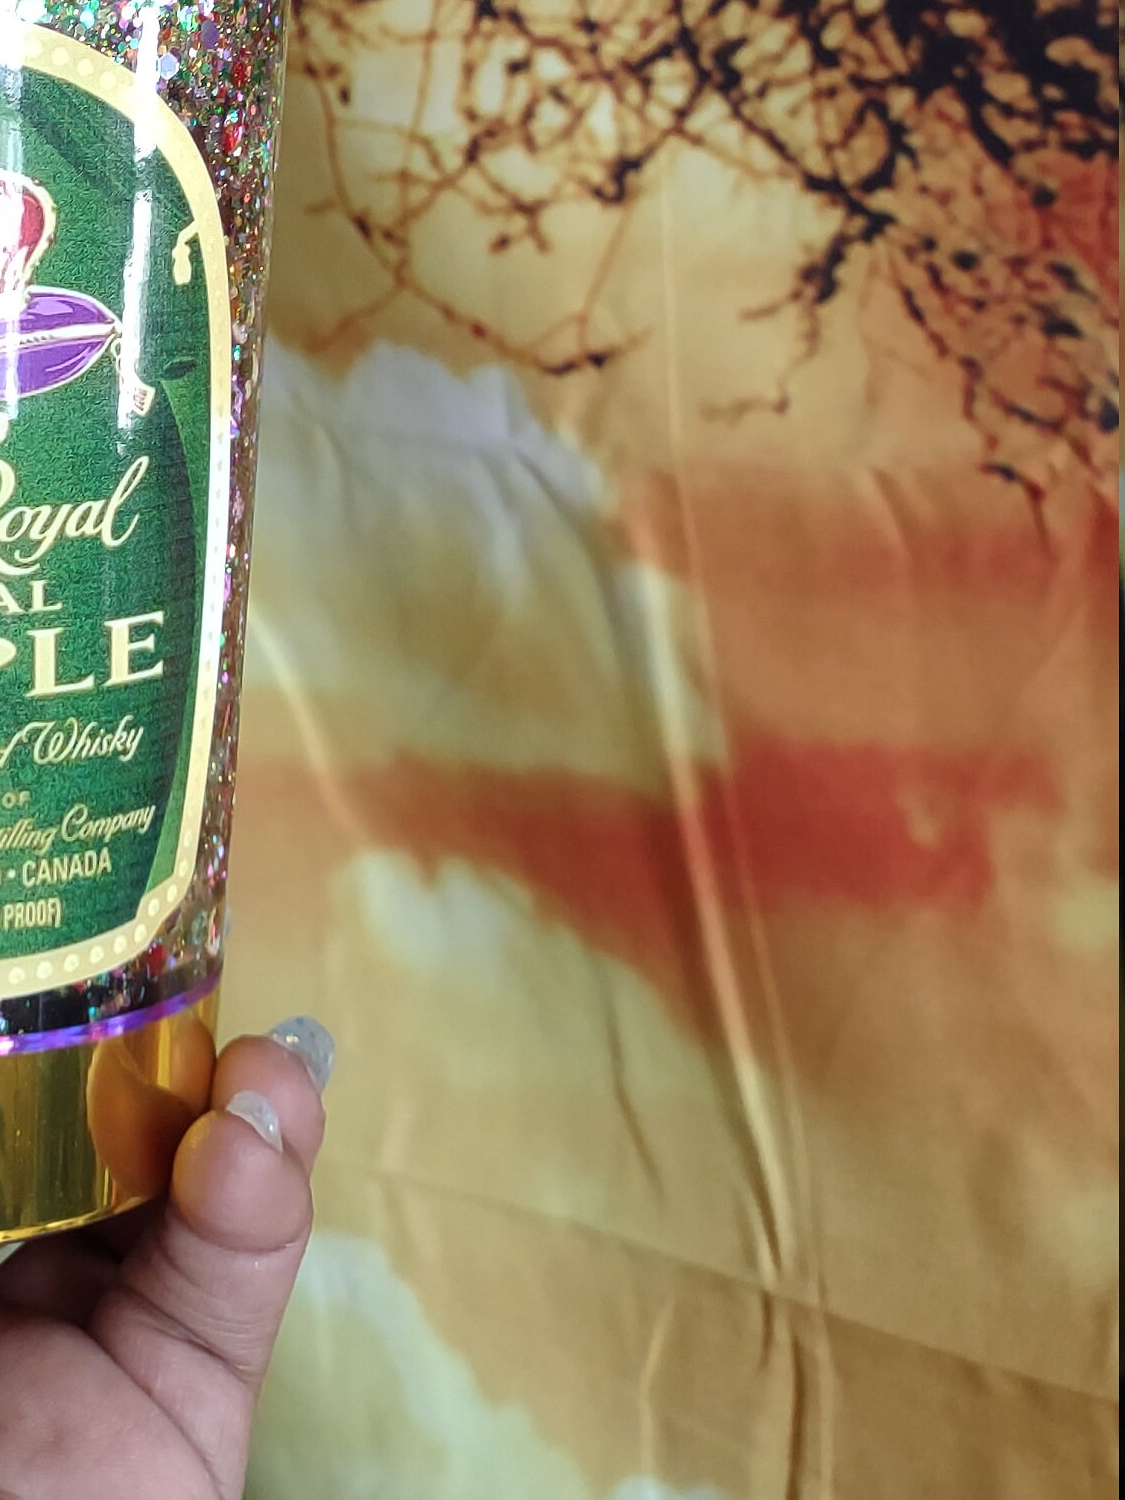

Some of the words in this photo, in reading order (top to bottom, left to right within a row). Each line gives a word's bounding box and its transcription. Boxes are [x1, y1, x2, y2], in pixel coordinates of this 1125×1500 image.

[22, 713, 145, 765] Whisky
[2, 790, 32, 809] OF
[61, 803, 157, 844] Company
[22, 846, 112, 889] CANADA
[3, 897, 62, 930] PROOF)
